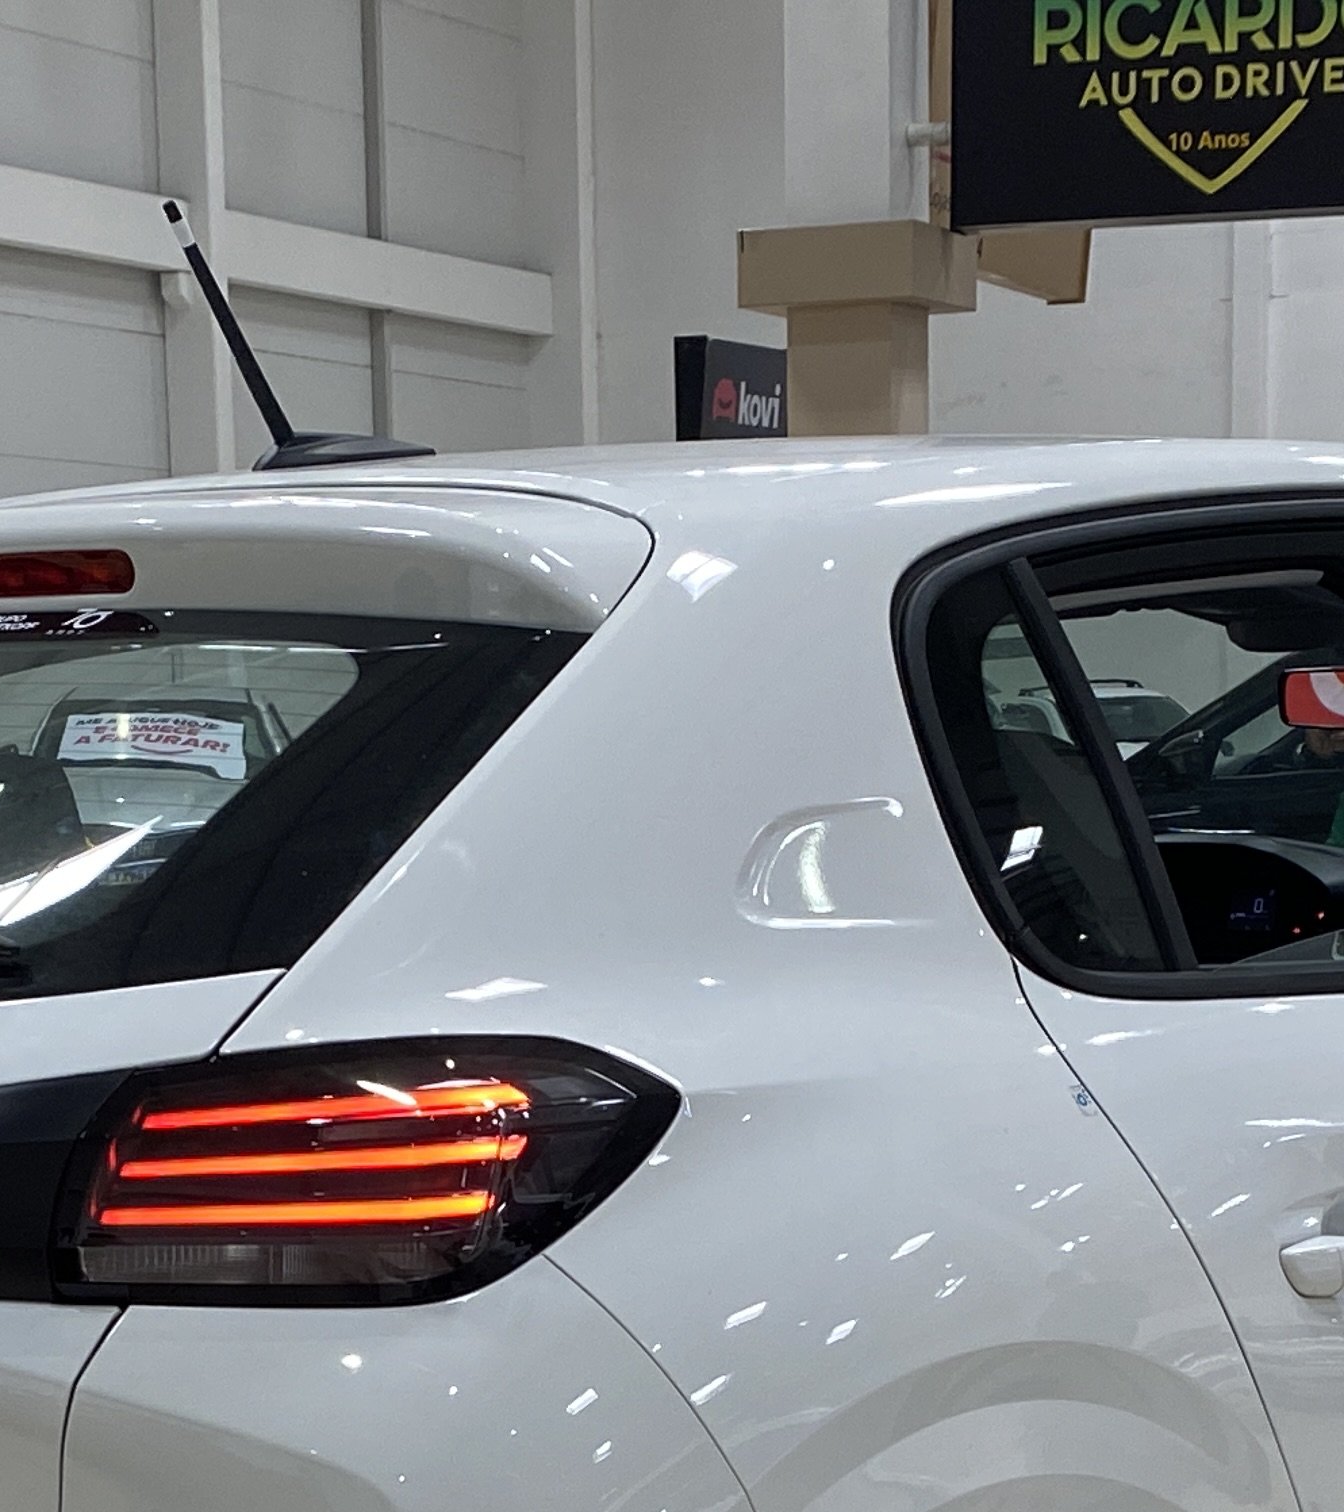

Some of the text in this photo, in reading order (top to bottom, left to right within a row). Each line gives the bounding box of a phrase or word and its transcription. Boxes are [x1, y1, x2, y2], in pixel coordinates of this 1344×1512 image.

[1078, 66, 1204, 109] AUTO
[1167, 130, 1250, 152] 10 Anos
[737, 381, 782, 429] kovi
